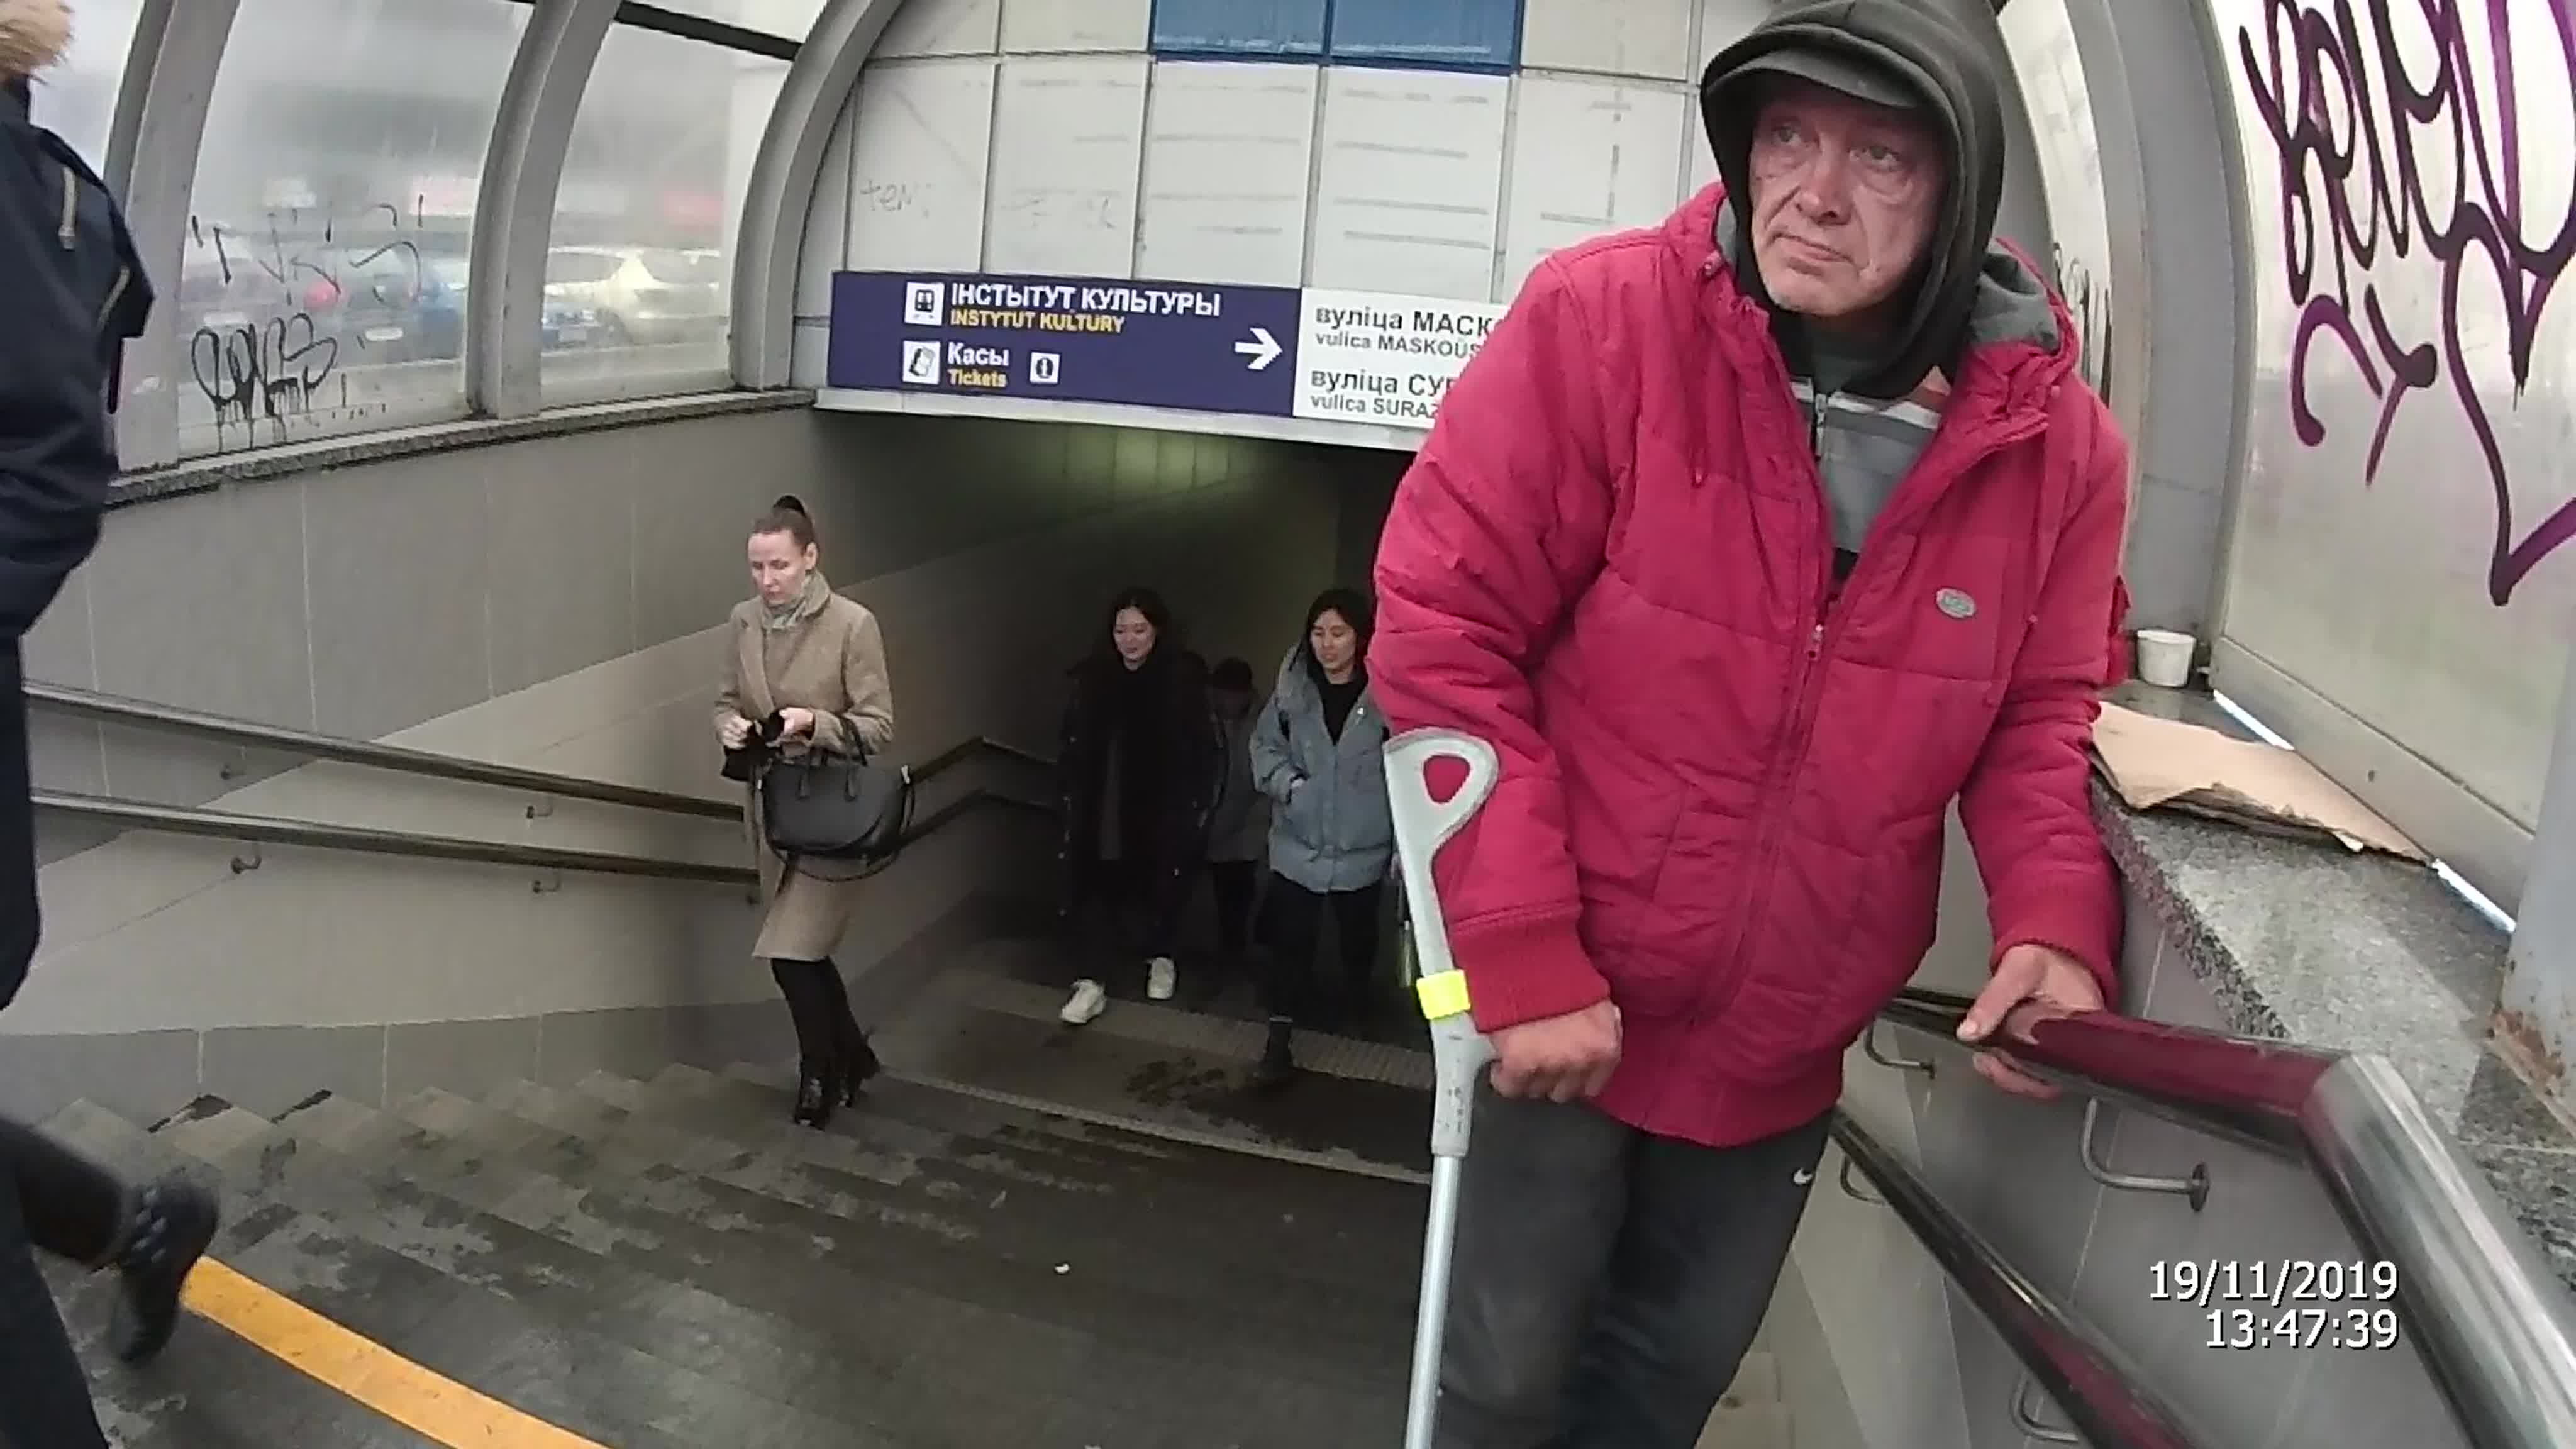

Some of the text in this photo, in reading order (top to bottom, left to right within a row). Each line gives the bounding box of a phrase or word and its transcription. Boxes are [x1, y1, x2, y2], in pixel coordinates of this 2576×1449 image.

[951, 282, 1221, 317] ІНСТЫТУТ КУЛЬТУРЫ
[950, 309, 1126, 333] INSTYTUT KULTURY
[1315, 306, 1403, 331] вуліца
[1315, 331, 1371, 348] vulica
[947, 341, 1009, 367] Касы
[947, 367, 1008, 388] Tickets
[1310, 368, 1398, 396] вуліца
[1310, 394, 1366, 413] vulica
